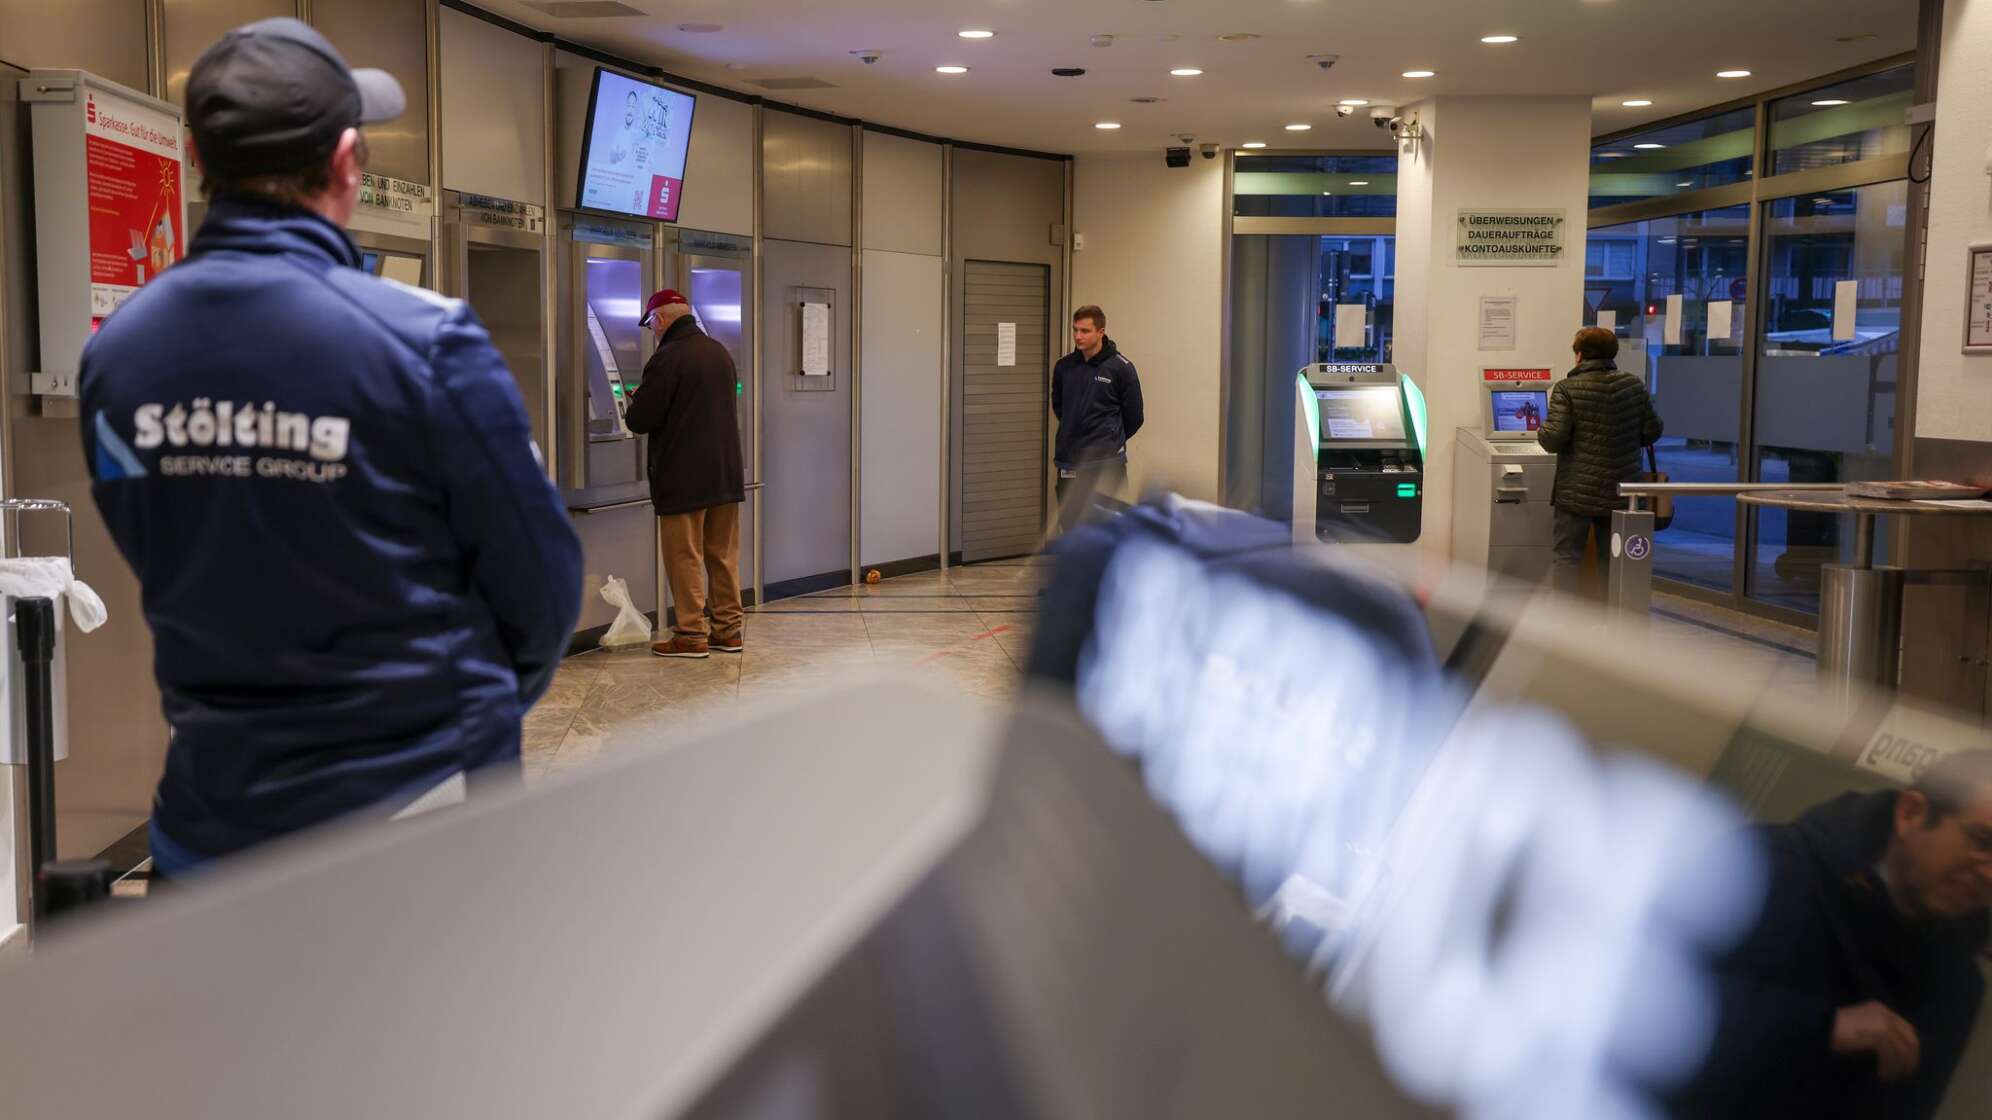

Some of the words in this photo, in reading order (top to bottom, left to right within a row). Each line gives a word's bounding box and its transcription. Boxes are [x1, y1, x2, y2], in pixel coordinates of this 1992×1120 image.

[98, 111, 129, 135] Sparkasse.
[130, 122, 140, 138] Gut
[361, 173, 376, 188] BEN
[378, 176, 390, 191] UND
[393, 180, 425, 198] EINZAHLEN
[360, 190, 374, 205] VON
[376, 193, 413, 211] BANKNOTEN
[1469, 215, 1554, 225] ÜBERWEISUNGEN
[1468, 229, 1553, 239] DAUERAUFTRÄGE
[1464, 243, 1557, 253] KONTOAUSKÜNFTE
[1326, 365, 1377, 373] SB-SERVICE
[134, 397, 350, 462] Stölting
[160, 455, 251, 478] SERVICE
[256, 456, 348, 483] GROUP
